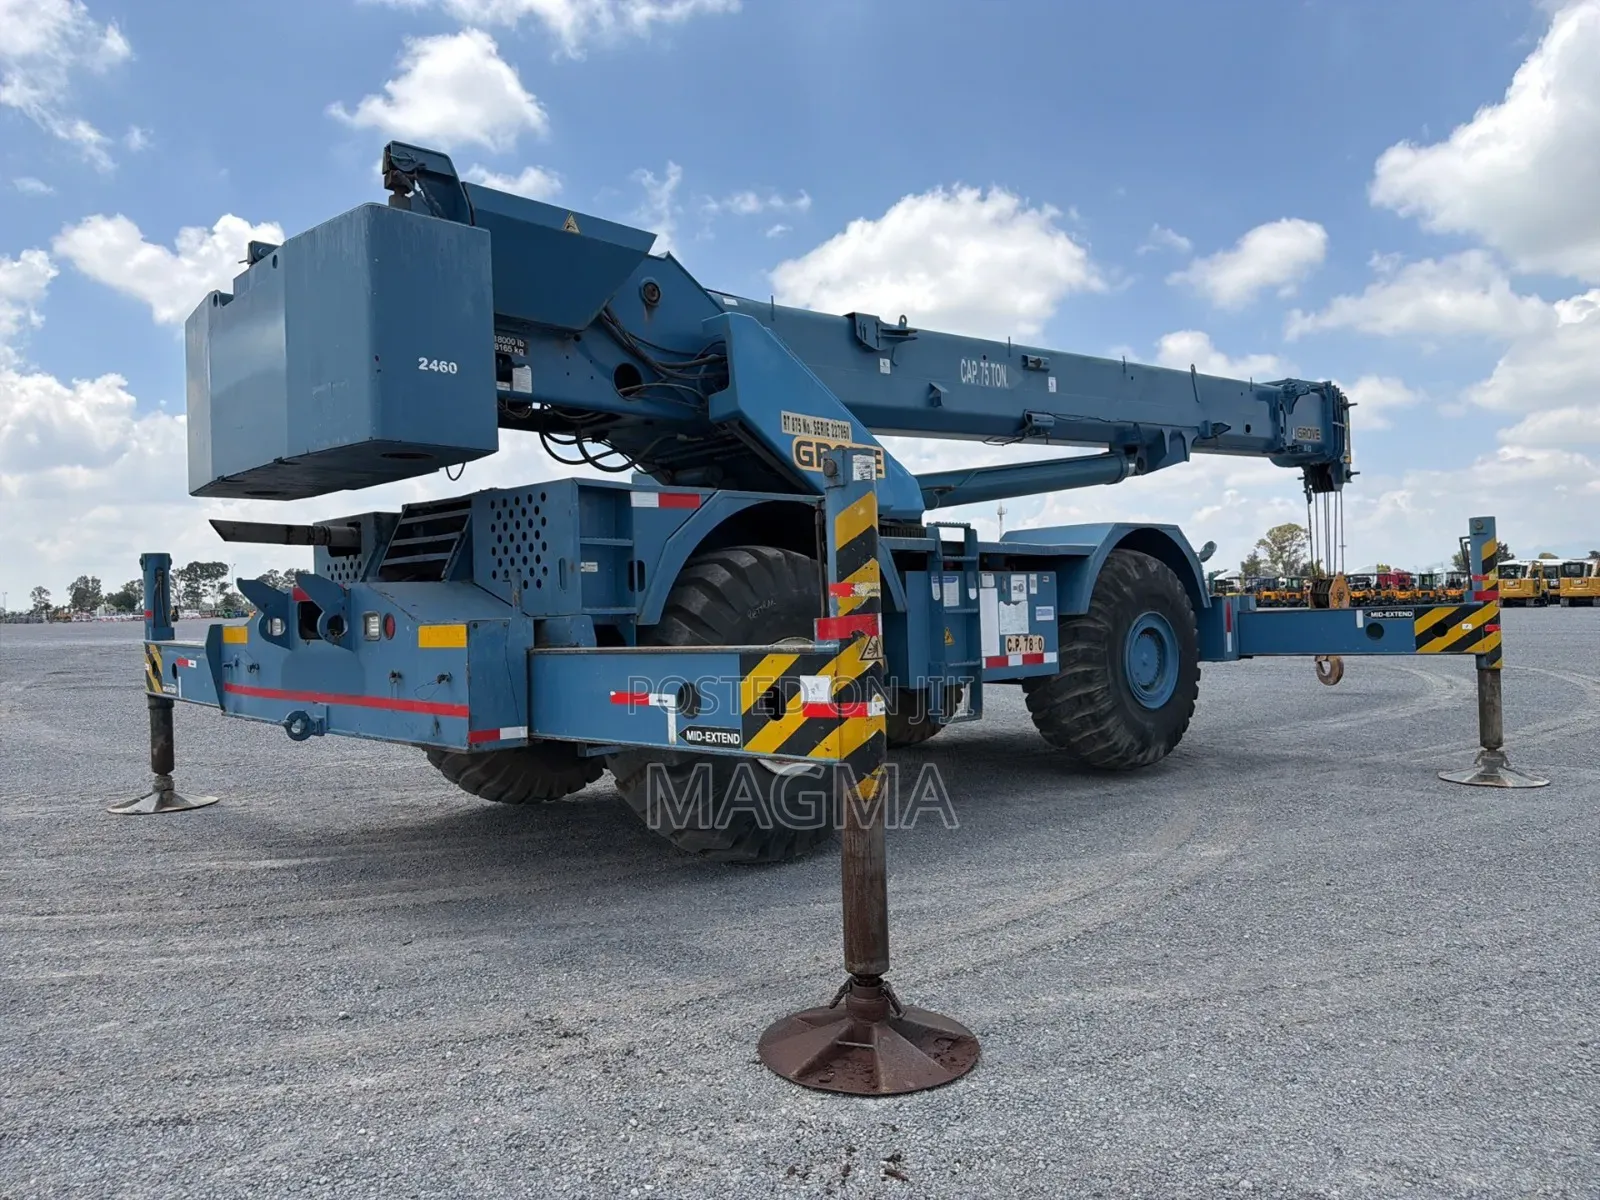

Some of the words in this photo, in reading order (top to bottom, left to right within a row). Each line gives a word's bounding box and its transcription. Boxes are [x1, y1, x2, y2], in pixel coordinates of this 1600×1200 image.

[418, 357, 458, 374] 2460
[960, 359, 979, 384] CAP.
[980, 362, 990, 386] 75
[990, 363, 1009, 388] TON.
[813, 420, 830, 437] SERIE
[686, 730, 740, 745] MID-EXTEND
